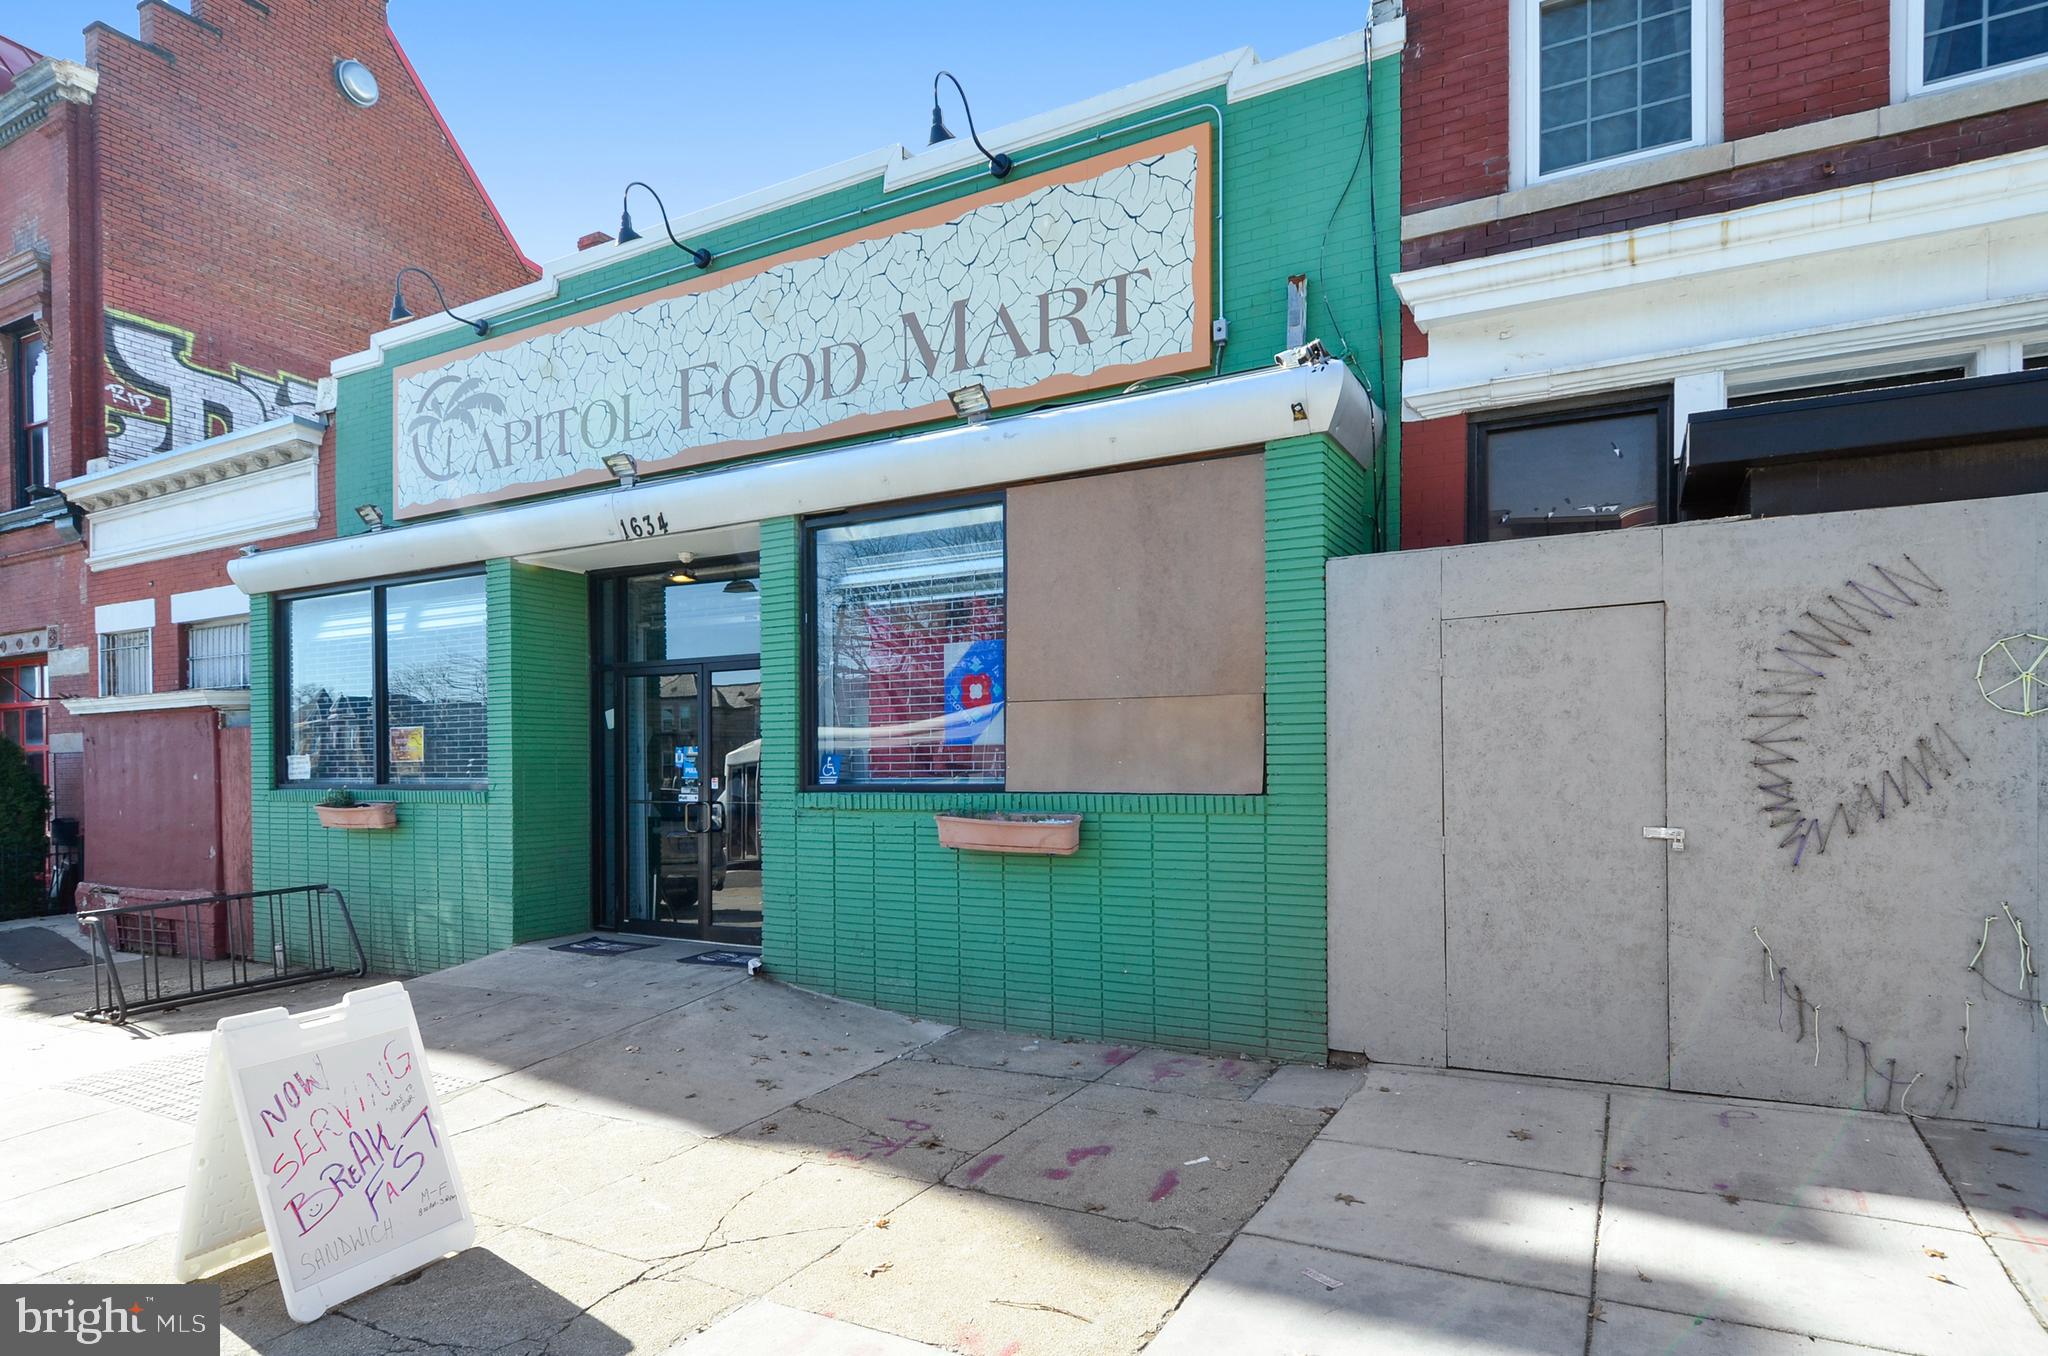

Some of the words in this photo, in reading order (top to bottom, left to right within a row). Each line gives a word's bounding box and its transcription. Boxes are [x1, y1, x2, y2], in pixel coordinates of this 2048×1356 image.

[105, 383, 151, 415] RIP
[408, 375, 654, 482] CAPITOL
[677, 342, 867, 432] FOOD
[899, 267, 1152, 385] MART
[620, 512, 669, 540] 1634
[273, 1039, 411, 1189] SERVING
[364, 1105, 438, 1222] FAST
[300, 1217, 394, 1281] SANDWICH
